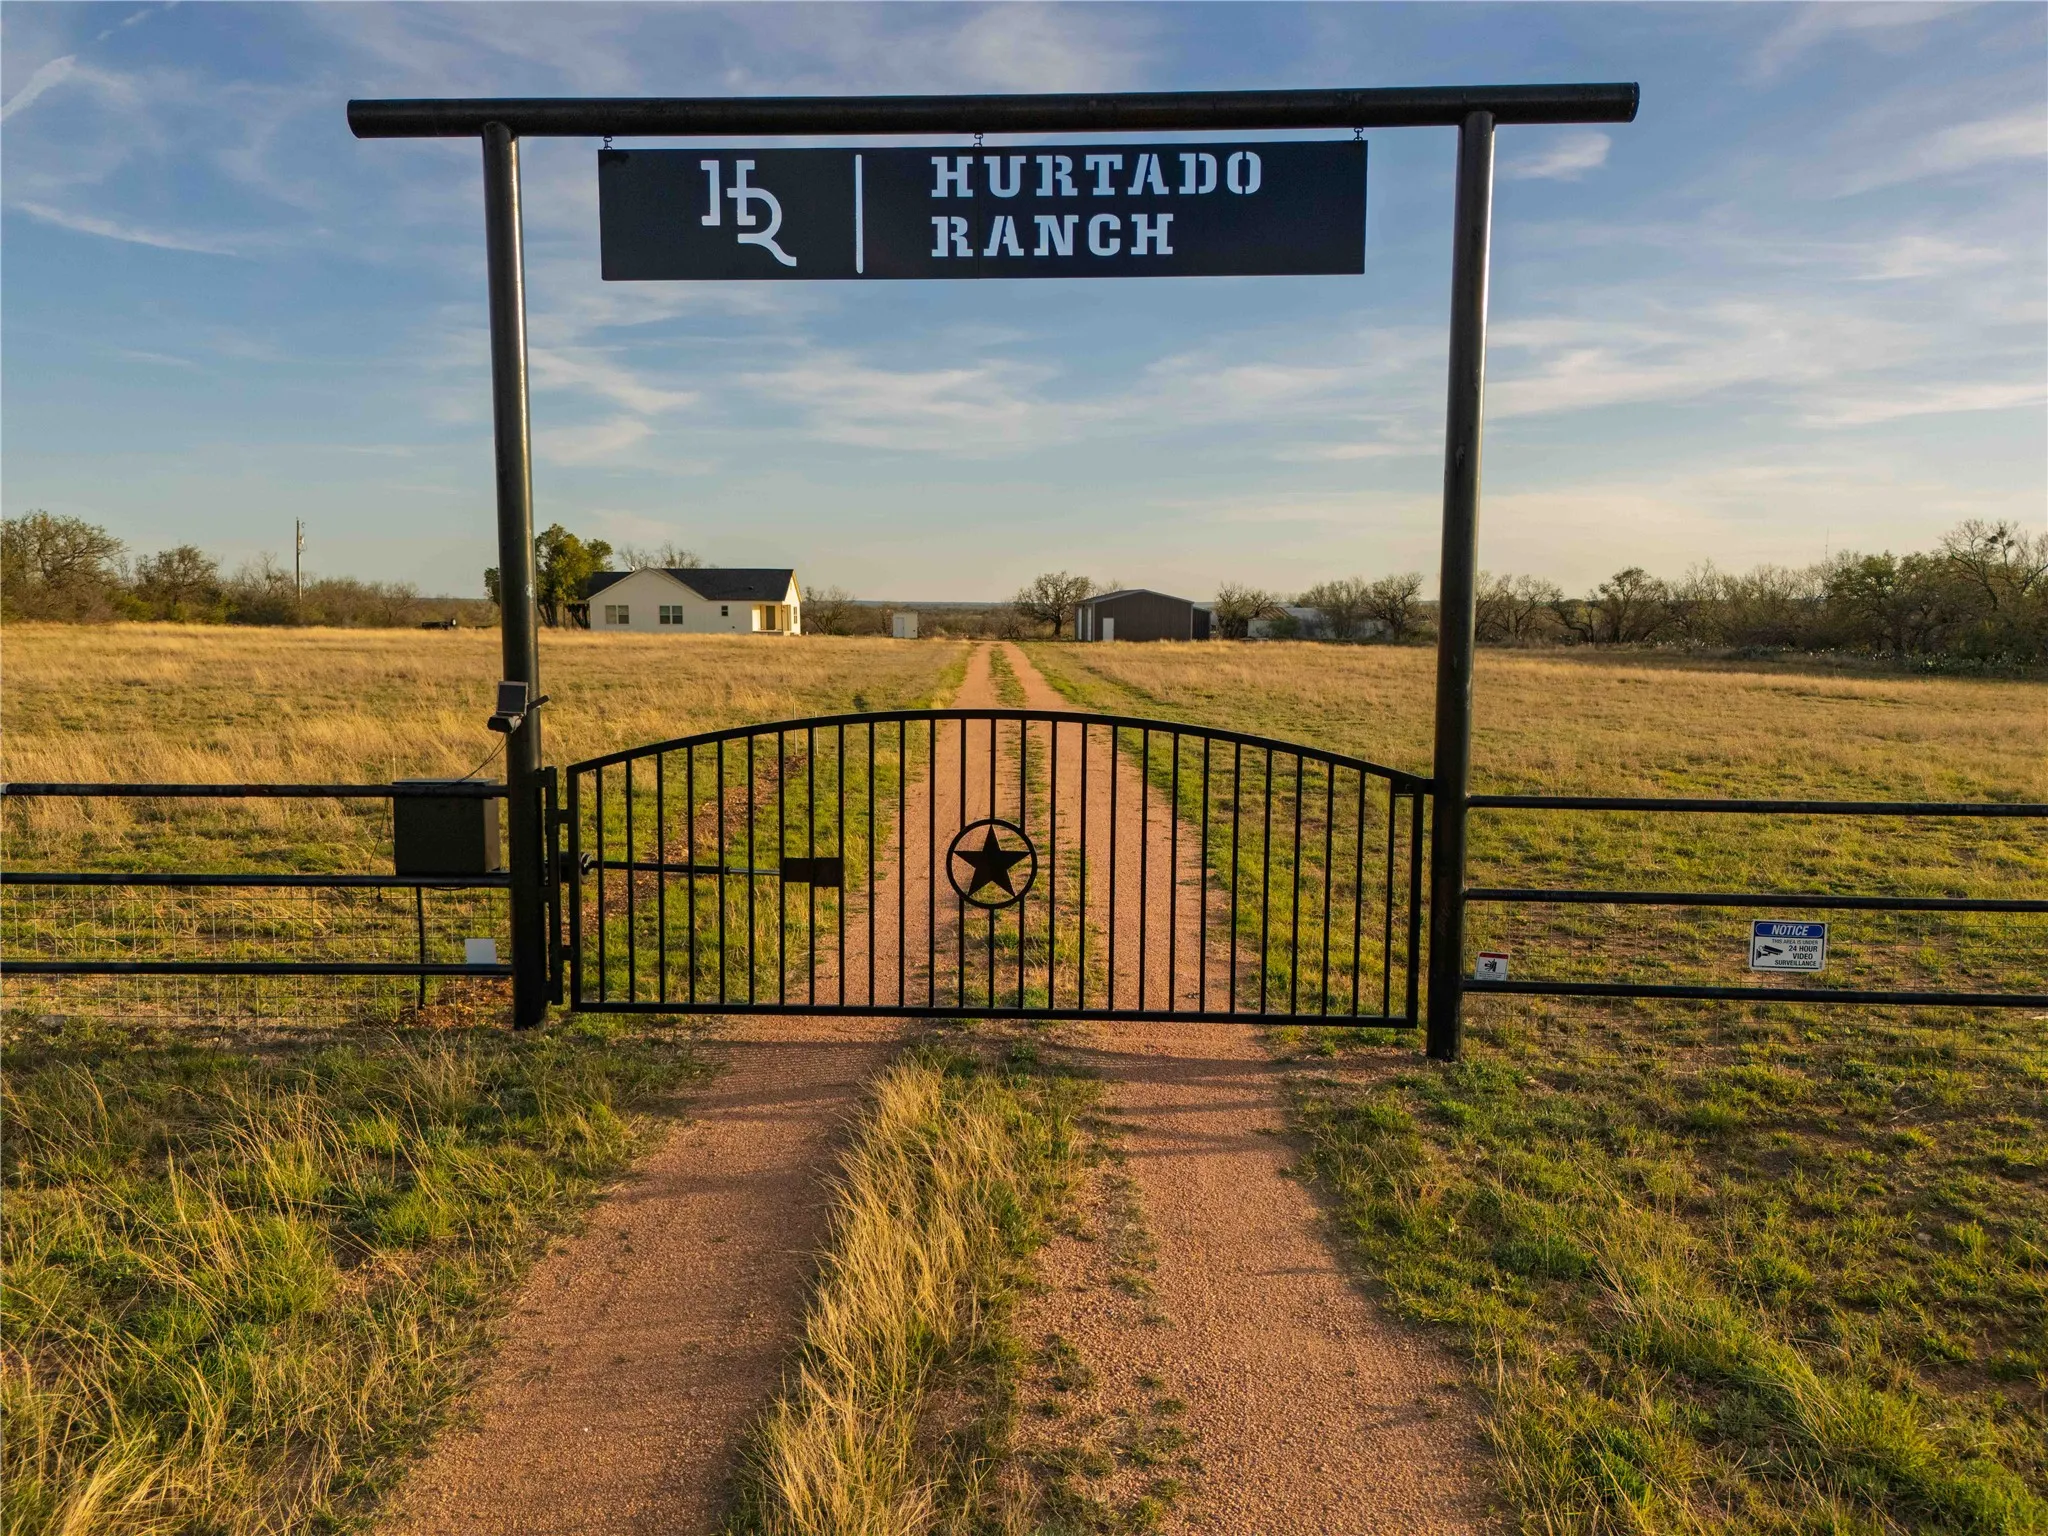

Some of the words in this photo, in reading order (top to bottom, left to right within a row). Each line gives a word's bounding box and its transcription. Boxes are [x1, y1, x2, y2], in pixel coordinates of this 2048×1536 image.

[932, 152, 1261, 197] HURTADO
[932, 214, 1173, 257] RANCH
[1771, 924, 1809, 936] NOTICE
